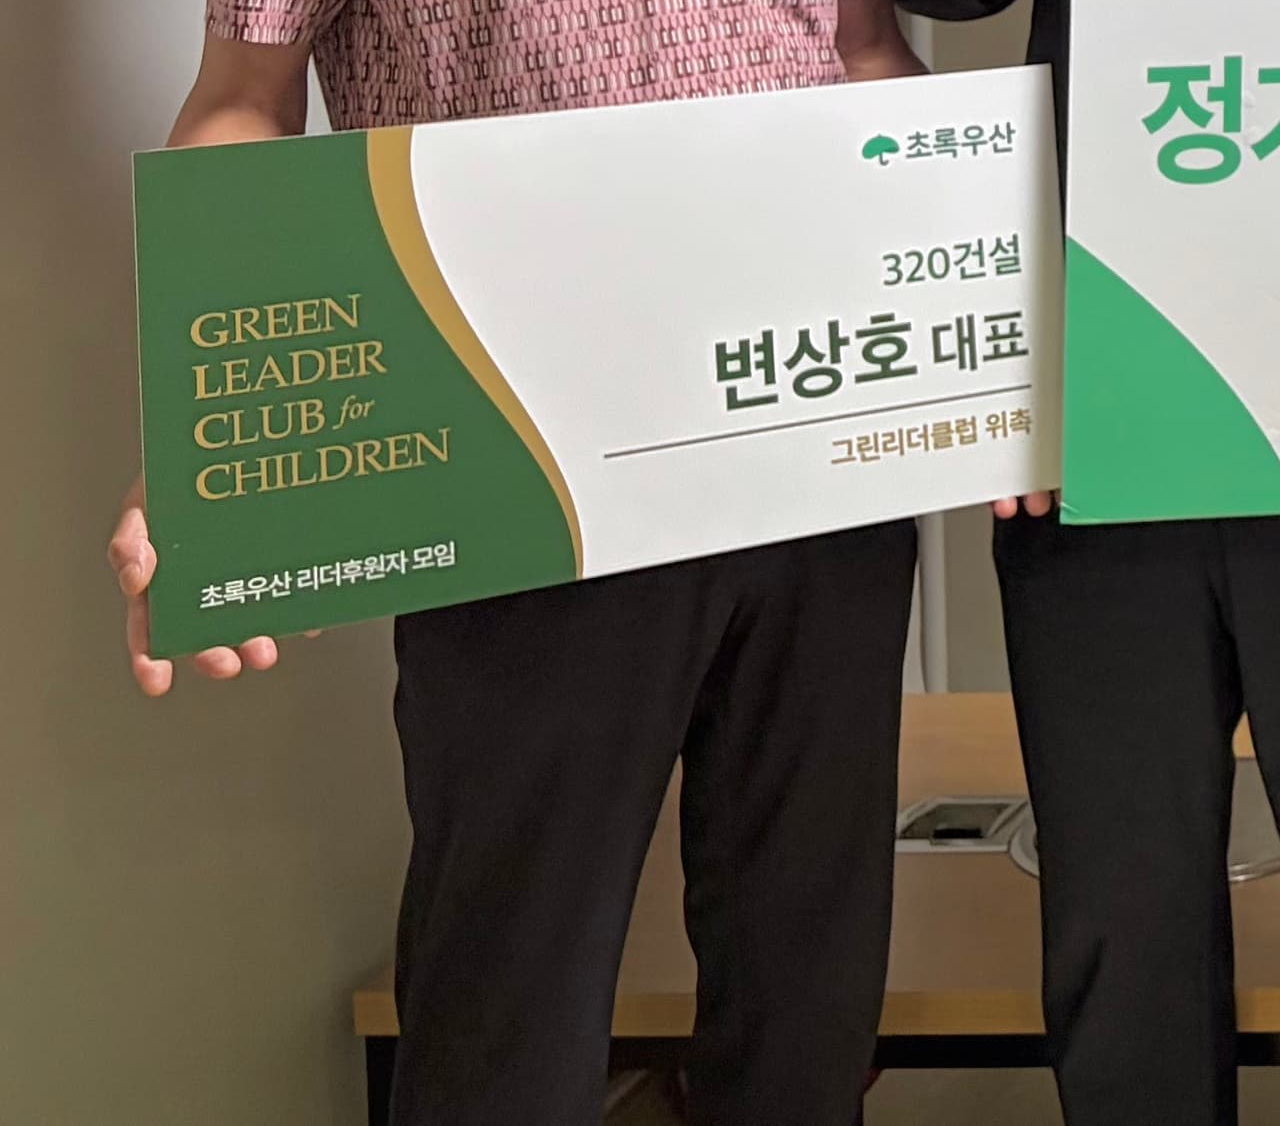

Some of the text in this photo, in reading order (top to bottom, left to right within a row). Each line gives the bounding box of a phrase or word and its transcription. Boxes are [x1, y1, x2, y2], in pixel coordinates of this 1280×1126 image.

[905, 121, 1016, 160] 초록우산
[882, 233, 1023, 287] 320건설
[190, 293, 362, 349] GREEN
[192, 340, 388, 401] LEADER
[714, 310, 1030, 411] 변상호 대표
[193, 394, 376, 450] CLUB for
[830, 408, 1033, 465] 그린리더클럽 위촉
[195, 427, 452, 501] CHILDREN
[199, 541, 457, 609] 초록우산 리더후원자 모임
